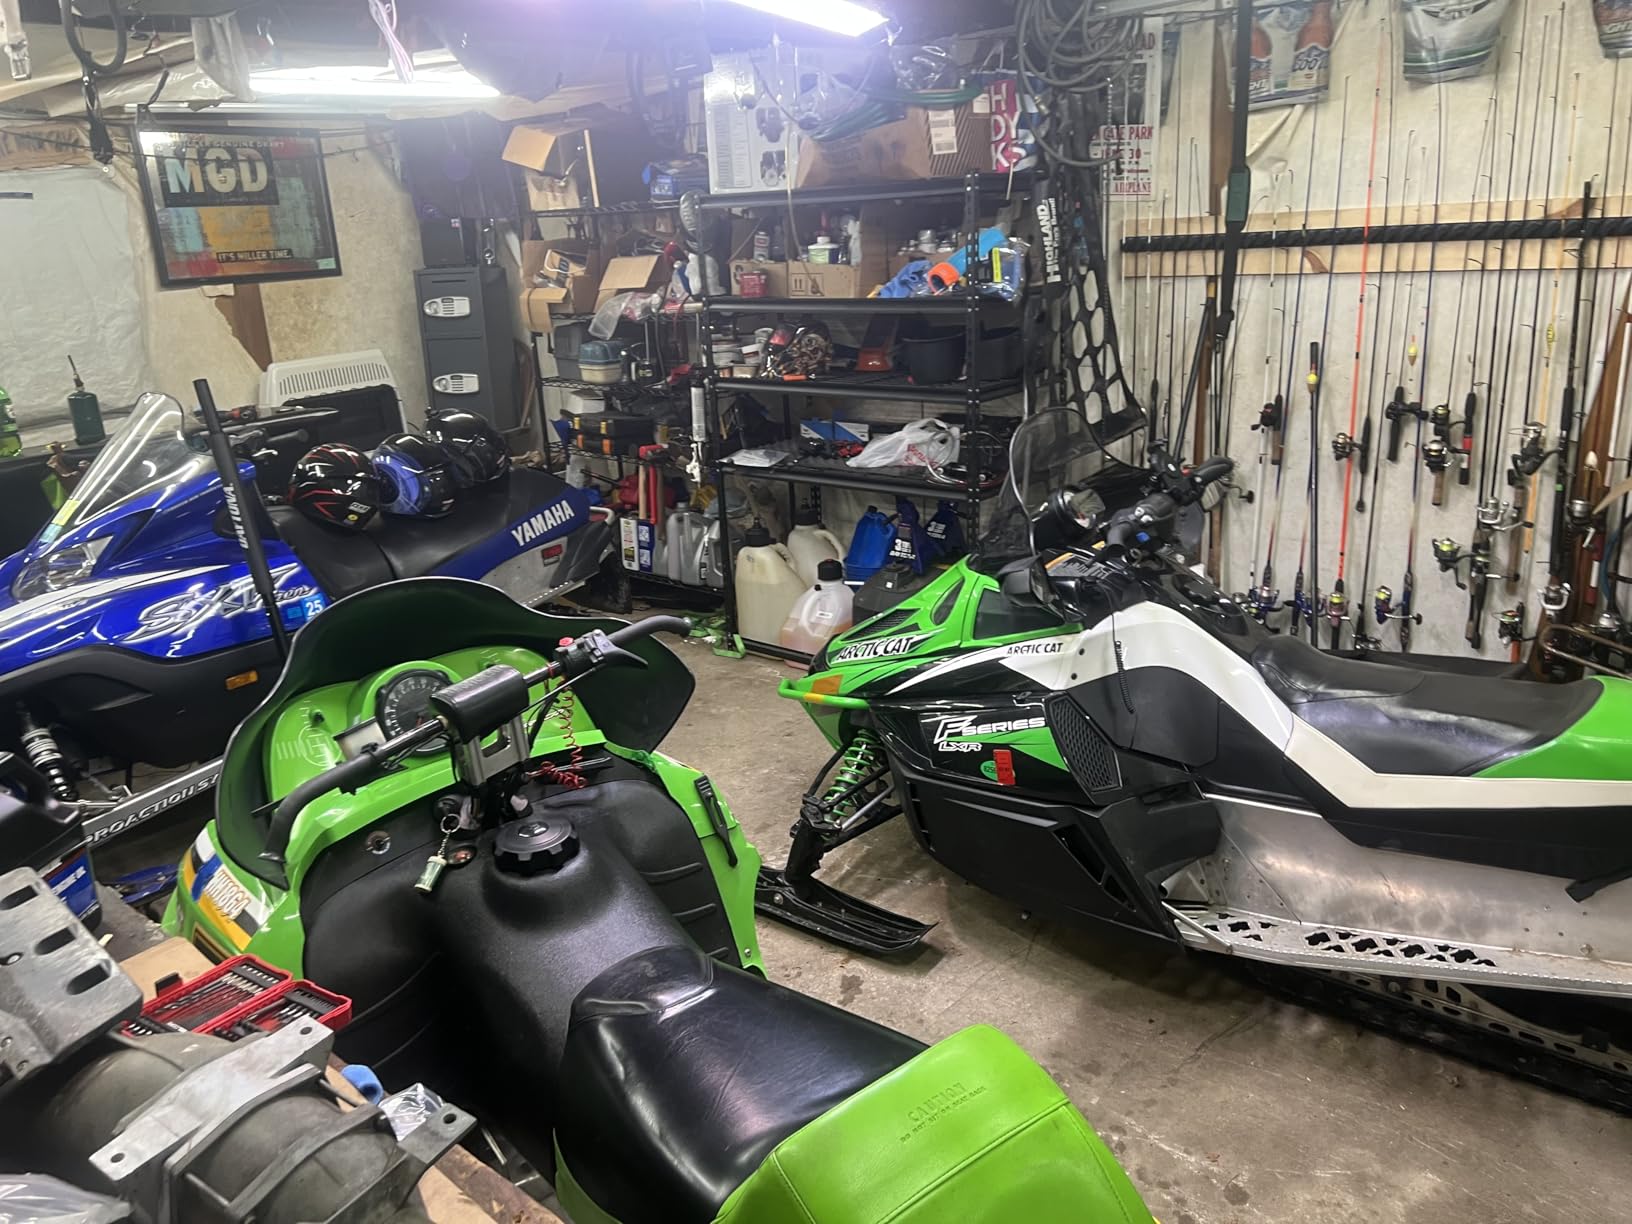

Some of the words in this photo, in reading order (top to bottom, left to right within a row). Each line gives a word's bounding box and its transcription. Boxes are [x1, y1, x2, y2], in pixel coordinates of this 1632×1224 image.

[163, 147, 269, 193] MGD
[1036, 204, 1062, 284] HIGHLAND
[237, 251, 269, 262] MILLER
[511, 500, 575, 547] YAMAHA
[305, 599, 323, 616] 25
[837, 639, 887, 660] ARCTIC
[883, 636, 914, 655] CAT
[1006, 644, 1041, 655] ARCTIC
[1042, 642, 1064, 654] CAT
[961, 717, 1046, 737] SERIES
